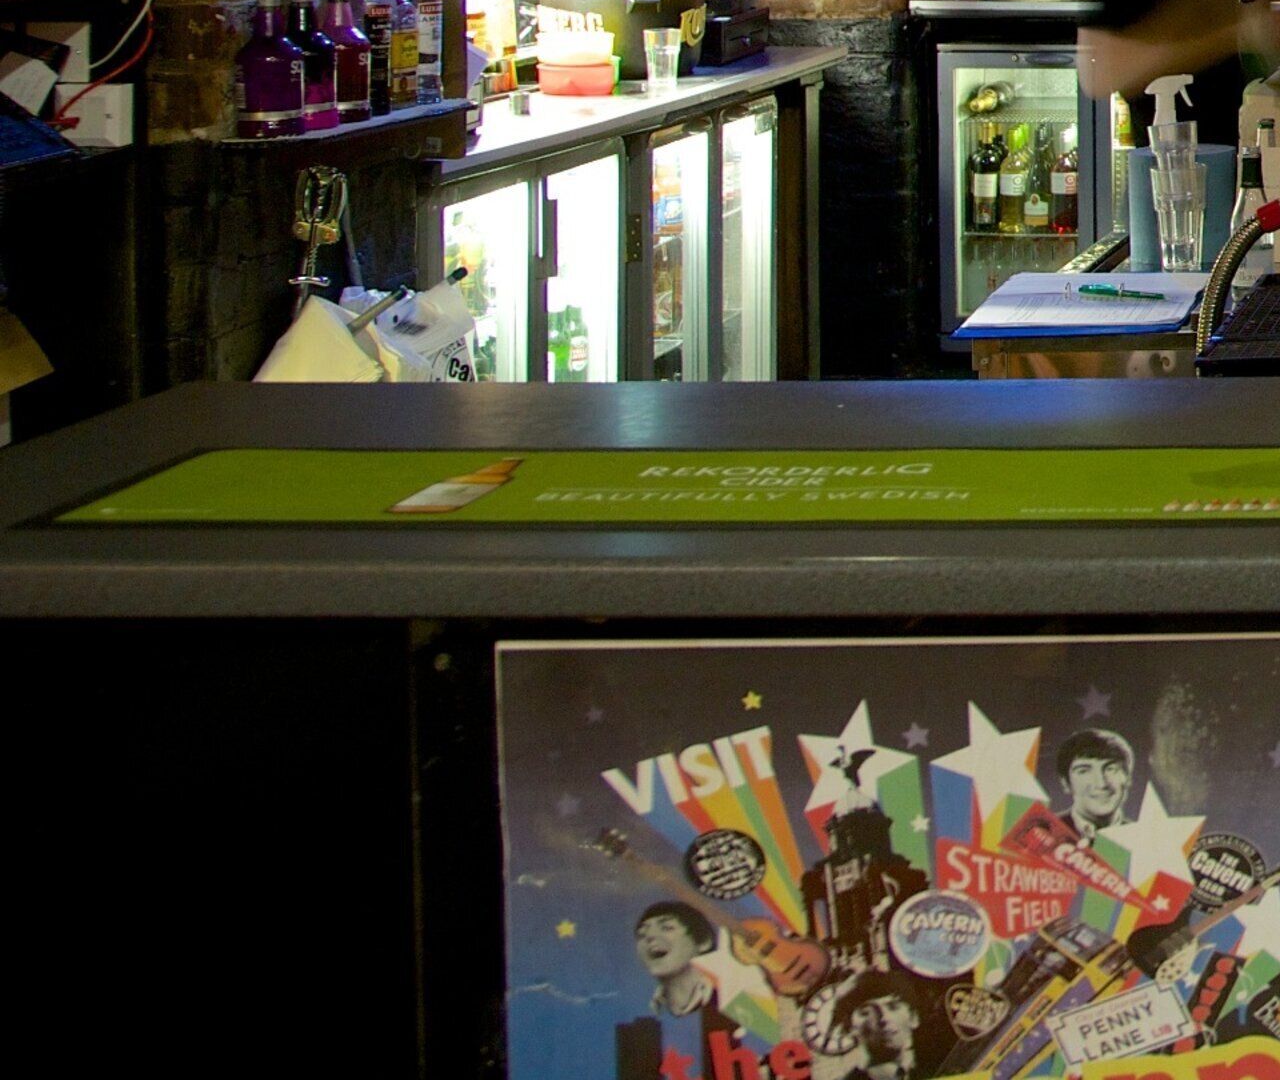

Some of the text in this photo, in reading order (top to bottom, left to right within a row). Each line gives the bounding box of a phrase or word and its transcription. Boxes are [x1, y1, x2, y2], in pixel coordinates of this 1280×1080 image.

[639, 463, 933, 477] REKORDERLIG
[720, 477, 826, 487] CIDER
[536, 489, 971, 502] BEAUTIFULLY SWEDISH
[601, 725, 776, 815] VISIT
[1054, 843, 1133, 899] CAVERN
[1191, 850, 1254, 892] Cavern
[1220, 852, 1240, 868] THE
[1199, 878, 1226, 897] CLUB
[901, 911, 984, 936] CAVERN
[1004, 895, 1063, 933] FIELD
[1080, 995, 1155, 1038] PENNY
[1081, 1028, 1143, 1062] LANE
